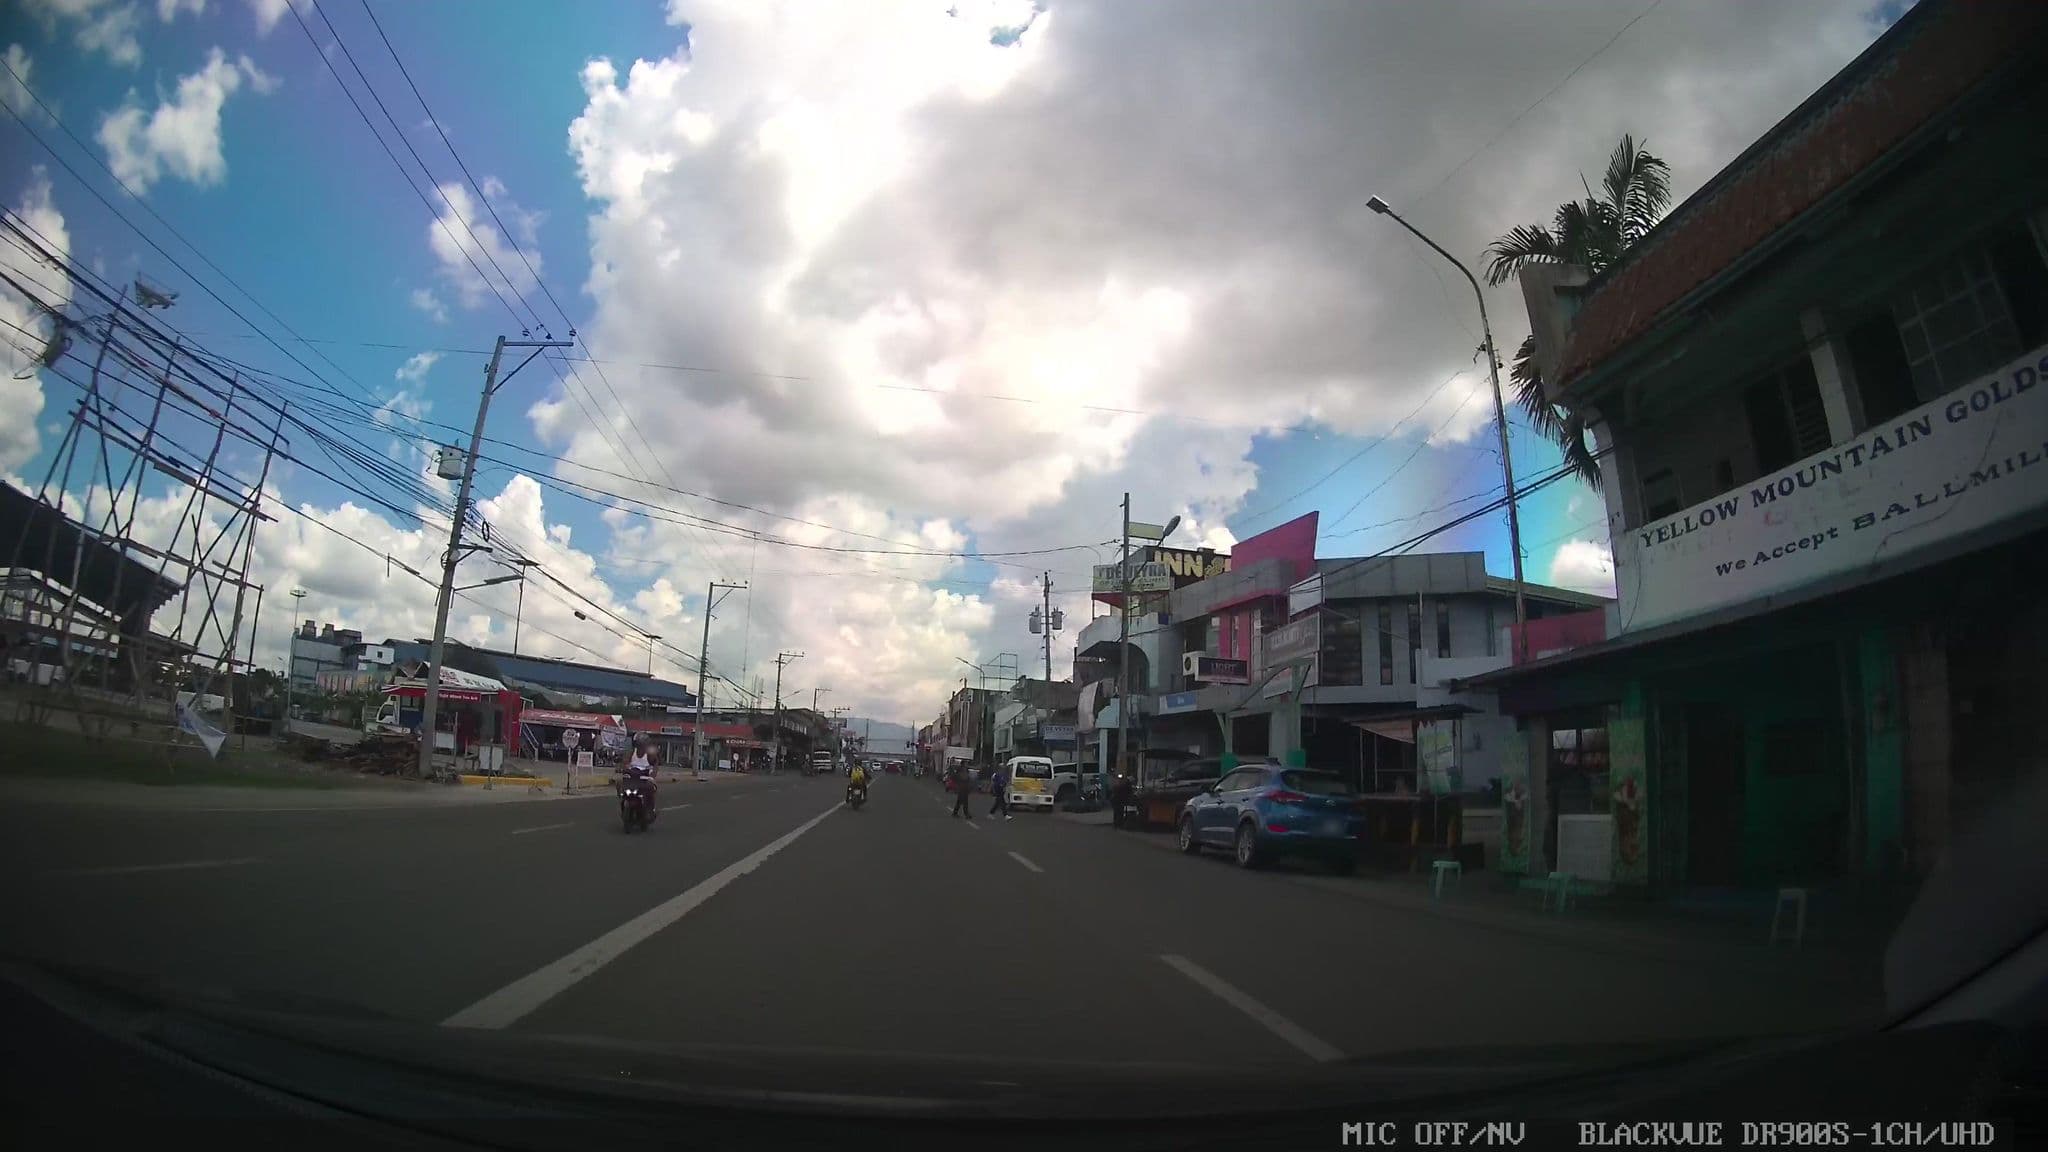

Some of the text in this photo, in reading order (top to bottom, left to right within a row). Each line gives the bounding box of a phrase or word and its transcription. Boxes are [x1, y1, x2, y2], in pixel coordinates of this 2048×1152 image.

[1640, 497, 1739, 549] YELLOW
[1751, 415, 1932, 508] MOUNTAIN
[1154, 551, 1203, 577] INN
[1715, 559, 1746, 577] We
[1753, 527, 1838, 566] Accept
